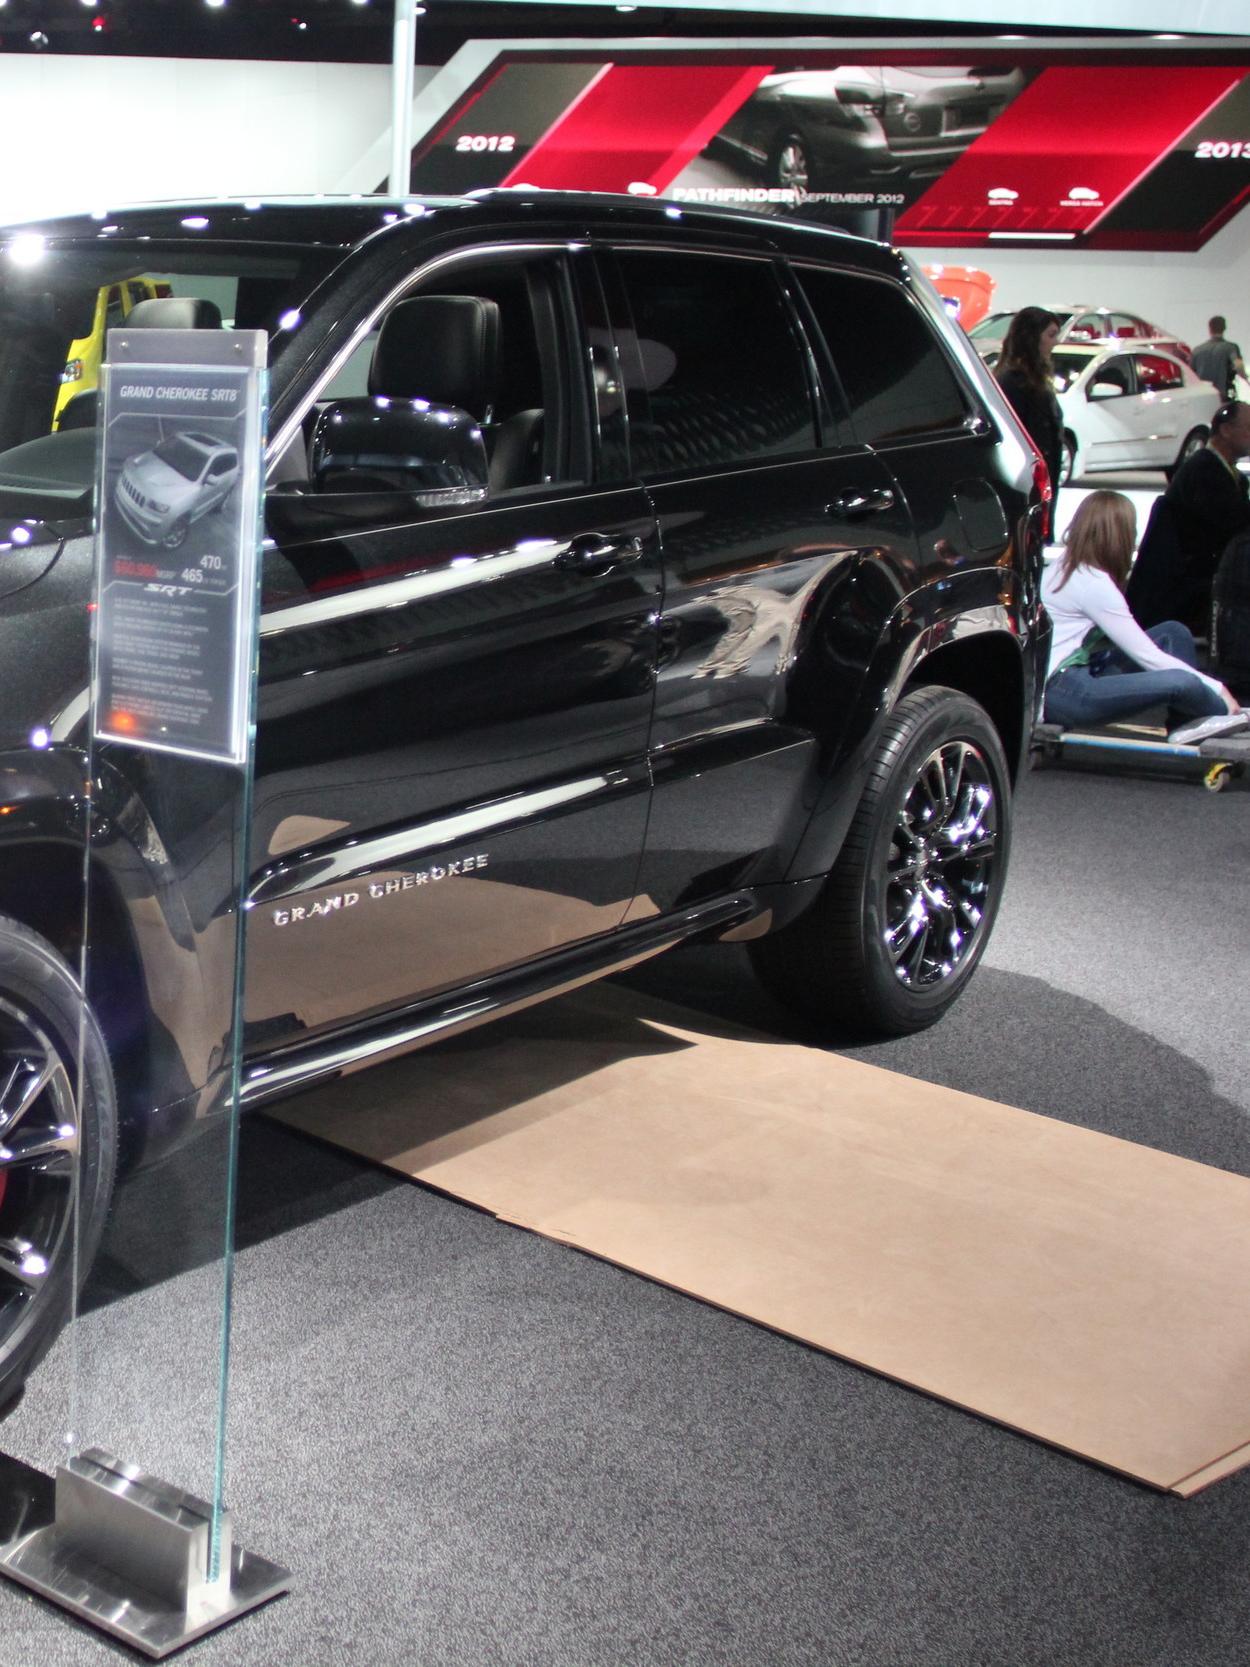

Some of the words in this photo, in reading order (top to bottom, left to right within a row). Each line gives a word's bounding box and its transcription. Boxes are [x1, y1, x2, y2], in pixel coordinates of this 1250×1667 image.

[455, 135, 515, 152] 2012
[672, 187, 796, 203] PATHFINDER
[800, 192, 874, 204] SEPTEMBER
[876, 193, 905, 204] 2012
[120, 385, 154, 398] GRAND
[155, 386, 210, 400] CHEROKEE
[211, 388, 238, 401] SRT8
[200, 554, 222, 570] 470
[181, 567, 204, 583] 465
[143, 583, 193, 597] SRT
[273, 891, 360, 926] GRAND
[368, 853, 490, 899] CHEROKEE
